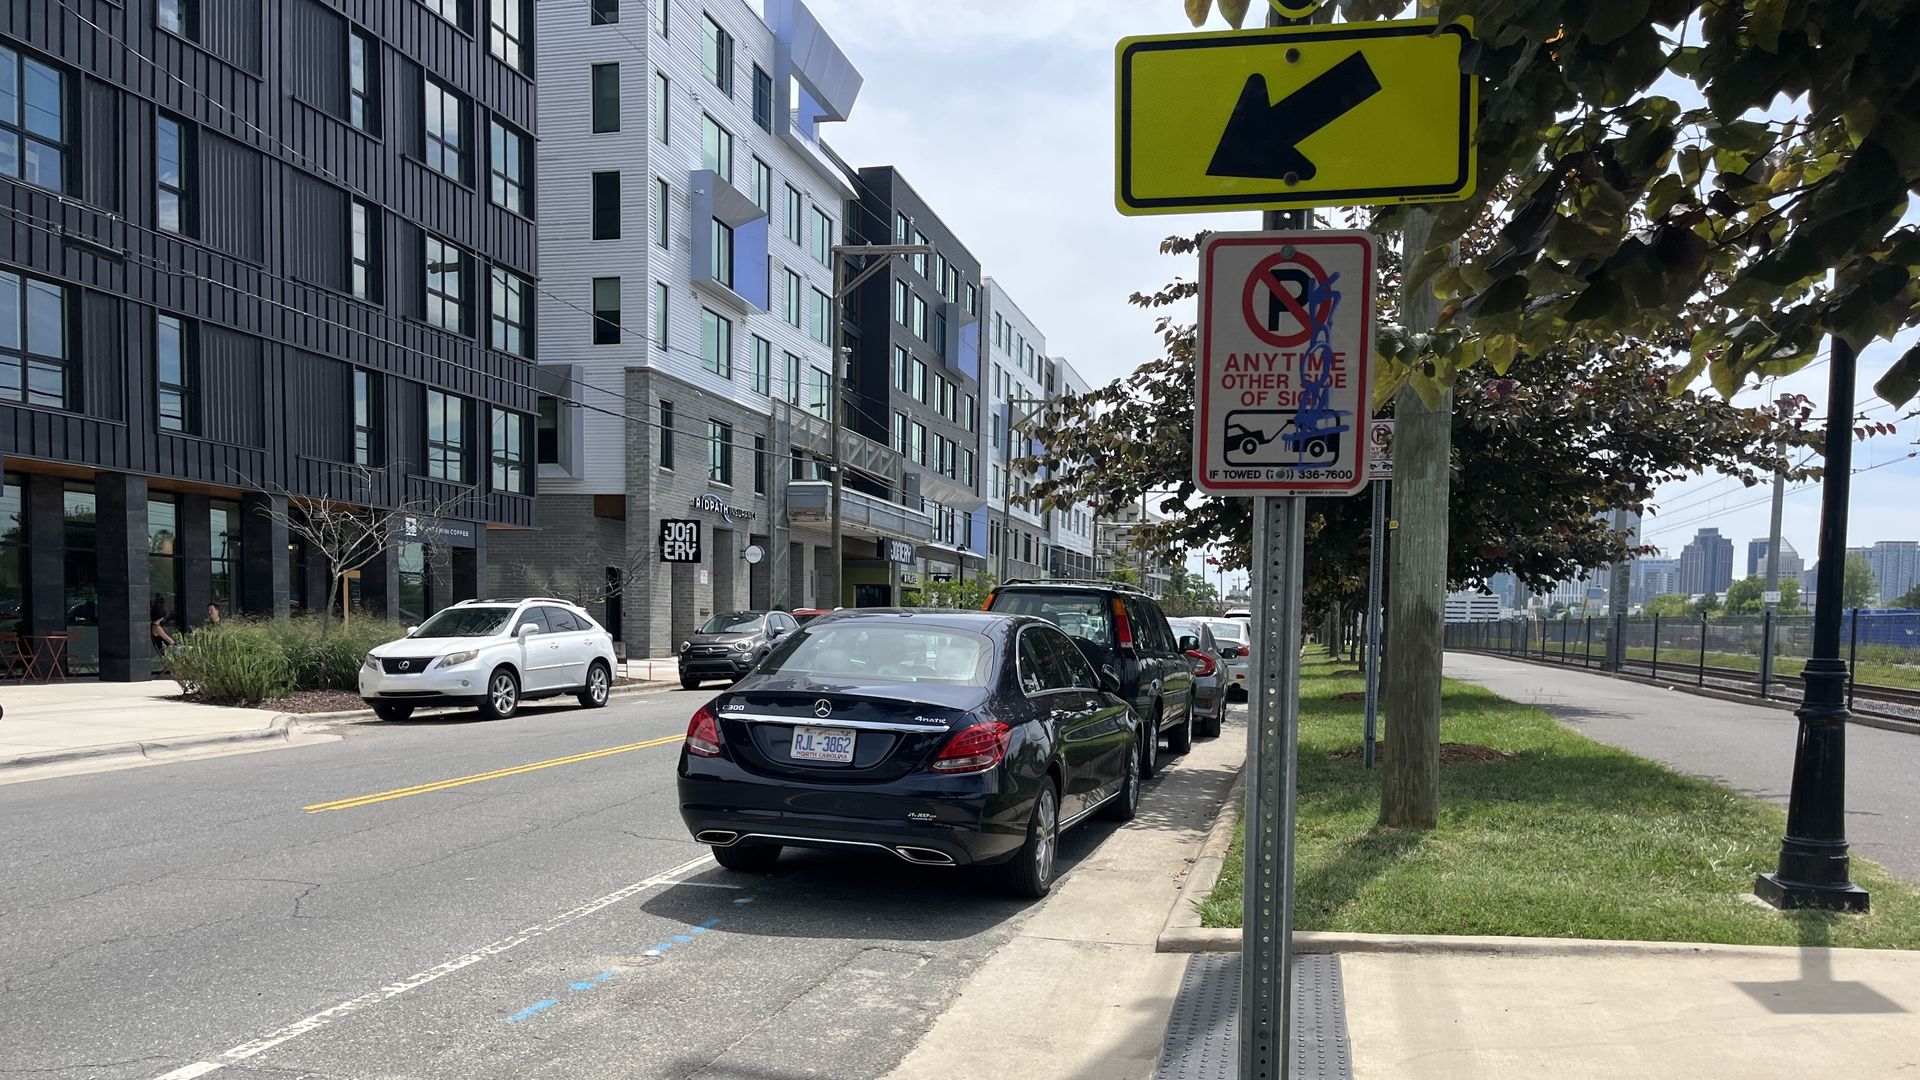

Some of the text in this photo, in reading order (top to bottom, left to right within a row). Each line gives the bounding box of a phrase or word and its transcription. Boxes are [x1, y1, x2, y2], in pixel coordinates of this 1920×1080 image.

[1222, 374, 1289, 389] OTHER
[1241, 391, 1269, 406] OF
[1209, 470, 1219, 479] IF
[1224, 470, 1261, 479] TOWED
[1298, 470, 1353, 480] 336-7600
[695, 497, 729, 515] RIDPATH
[450, 528, 469, 537] COFFEE
[664, 541, 697, 560] ERY
[795, 734, 851, 754] RJL-3862
